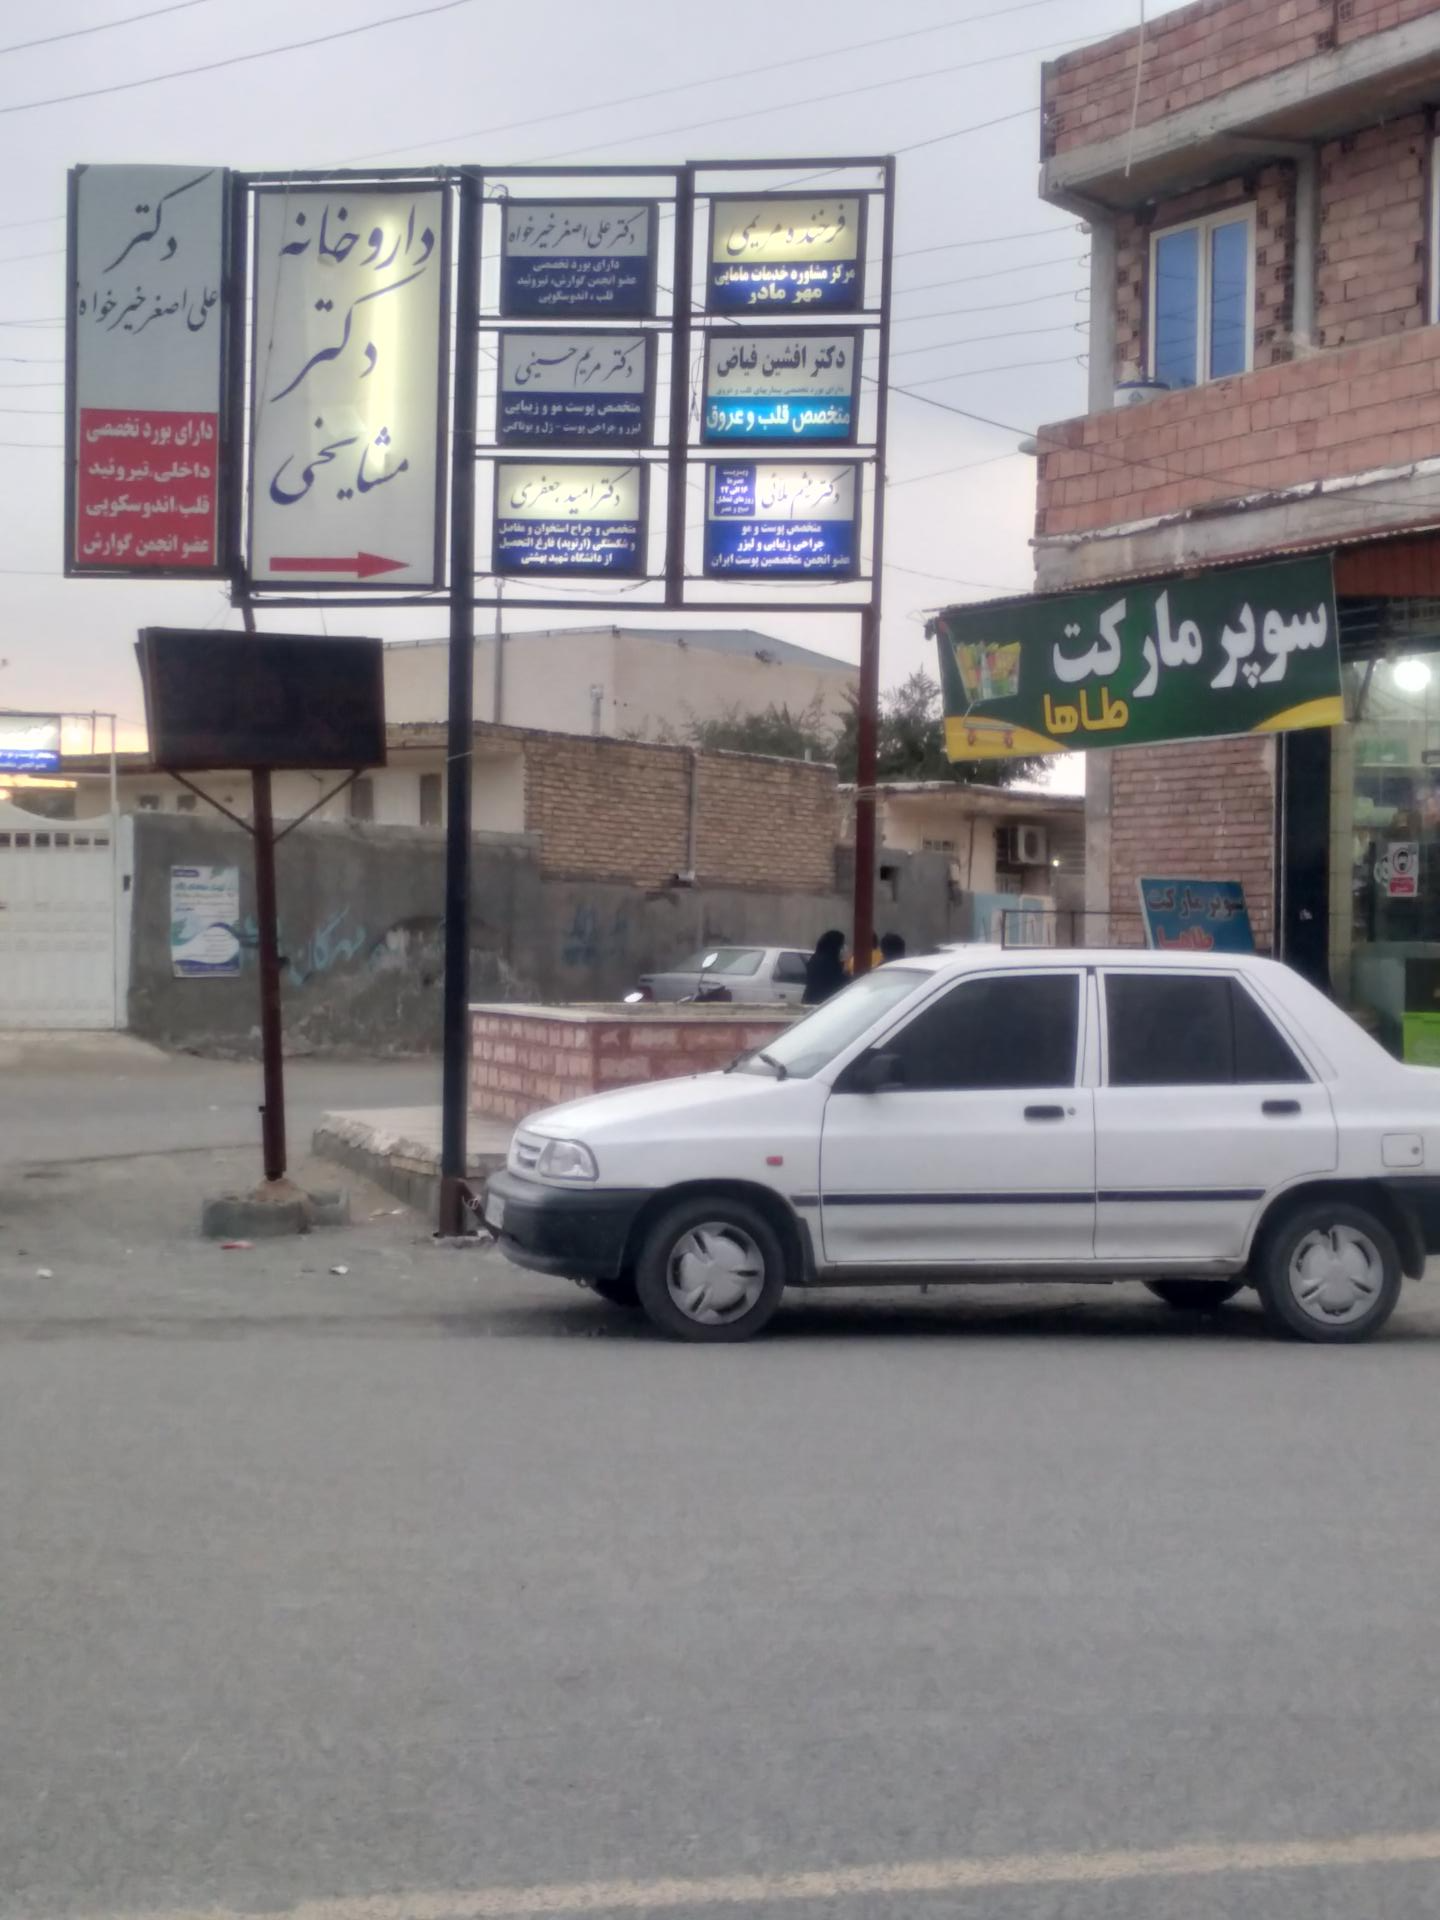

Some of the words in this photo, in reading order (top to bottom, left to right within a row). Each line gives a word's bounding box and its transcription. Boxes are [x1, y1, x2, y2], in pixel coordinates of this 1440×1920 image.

[103, 168, 216, 274] دکتر
[606, 208, 646, 249] دکتر
[785, 202, 847, 245] فرخنده
[279, 202, 436, 271] داروخانه
[551, 218, 588, 249] اصغر
[587, 219, 611, 249] علی
[726, 213, 783, 257] مریمی
[532, 258, 570, 273] تخصصی
[571, 258, 592, 273] بورد
[592, 258, 620, 273] دارای
[714, 266, 750, 286] مامایی
[750, 264, 789, 283] خدمات
[790, 264, 829, 286] مشاوره
[829, 263, 857, 285] مرکز
[586, 274, 616, 289] انجمن
[617, 275, 638, 289] عضو
[595, 290, 614, 304] قلب
[747, 282, 788, 305] مادر
[791, 286, 824, 305] مهر
[132, 287, 188, 335] اصغر
[186, 285, 218, 333] علی
[269, 266, 427, 404] دکتر
[514, 346, 579, 386] حسینی
[573, 346, 602, 389] مریم
[601, 336, 646, 383] دکتر
[716, 343, 759, 378] فیاض
[762, 343, 808, 378] افشین
[809, 344, 847, 378] دکتر
[504, 399, 540, 417] زیبایی
[542, 404, 548, 417] و
[550, 403, 563, 418] مو
[564, 401, 597, 418] پوست
[597, 400, 641, 417] متخصص
[706, 404, 745, 433] عروق
[757, 402, 790, 431] قلب
[86, 416, 141, 443] تخصصی
[562, 422, 587, 435] پوست
[586, 421, 616, 435] جراحی
[624, 422, 642, 436] لیزر
[745, 410, 756, 433] و
[791, 404, 851, 434] متخصص
[142, 421, 173, 446] بورد
[173, 419, 214, 447] دارای
[269, 416, 409, 506] مشایخی
[510, 474, 561, 510] جعفری
[588, 467, 634, 512] دکتر
[811, 466, 852, 509] دکتر
[562, 483, 595, 515] امید
[534, 522, 569, 537] استخوان
[570, 523, 593, 537] جراح
[594, 526, 600, 537] و
[601, 523, 637, 537] متخصص
[741, 525, 753, 537] مو
[753, 525, 760, 536] و
[760, 523, 786, 537] پوست
[785, 524, 822, 537] متخصص
[83, 531, 133, 557] گوارش
[135, 533, 178, 557] انجمن
[181, 534, 209, 559] عضو
[534, 537, 555, 551] فارغ
[736, 536, 755, 552] لیزر
[755, 540, 763, 552] و
[763, 537, 791, 552] زیبایی
[792, 537, 826, 552] جراحی
[520, 552, 548, 565] بهشتی
[548, 551, 570, 564] شهید
[570, 552, 602, 564] دانشگاه
[604, 552, 613, 567] از
[711, 553, 735, 568] ایران
[735, 554, 760, 568] پوست
[760, 554, 803, 568] متخصصین
[802, 553, 831, 568] انجمن
[831, 555, 851, 568] عضو
[1051, 590, 1204, 698] مارکت
[1209, 600, 1329, 690] سوپر
[1042, 686, 1130, 735] طاها
[1146, 886, 1204, 919] مارکت
[1207, 894, 1246, 920] سوپر
